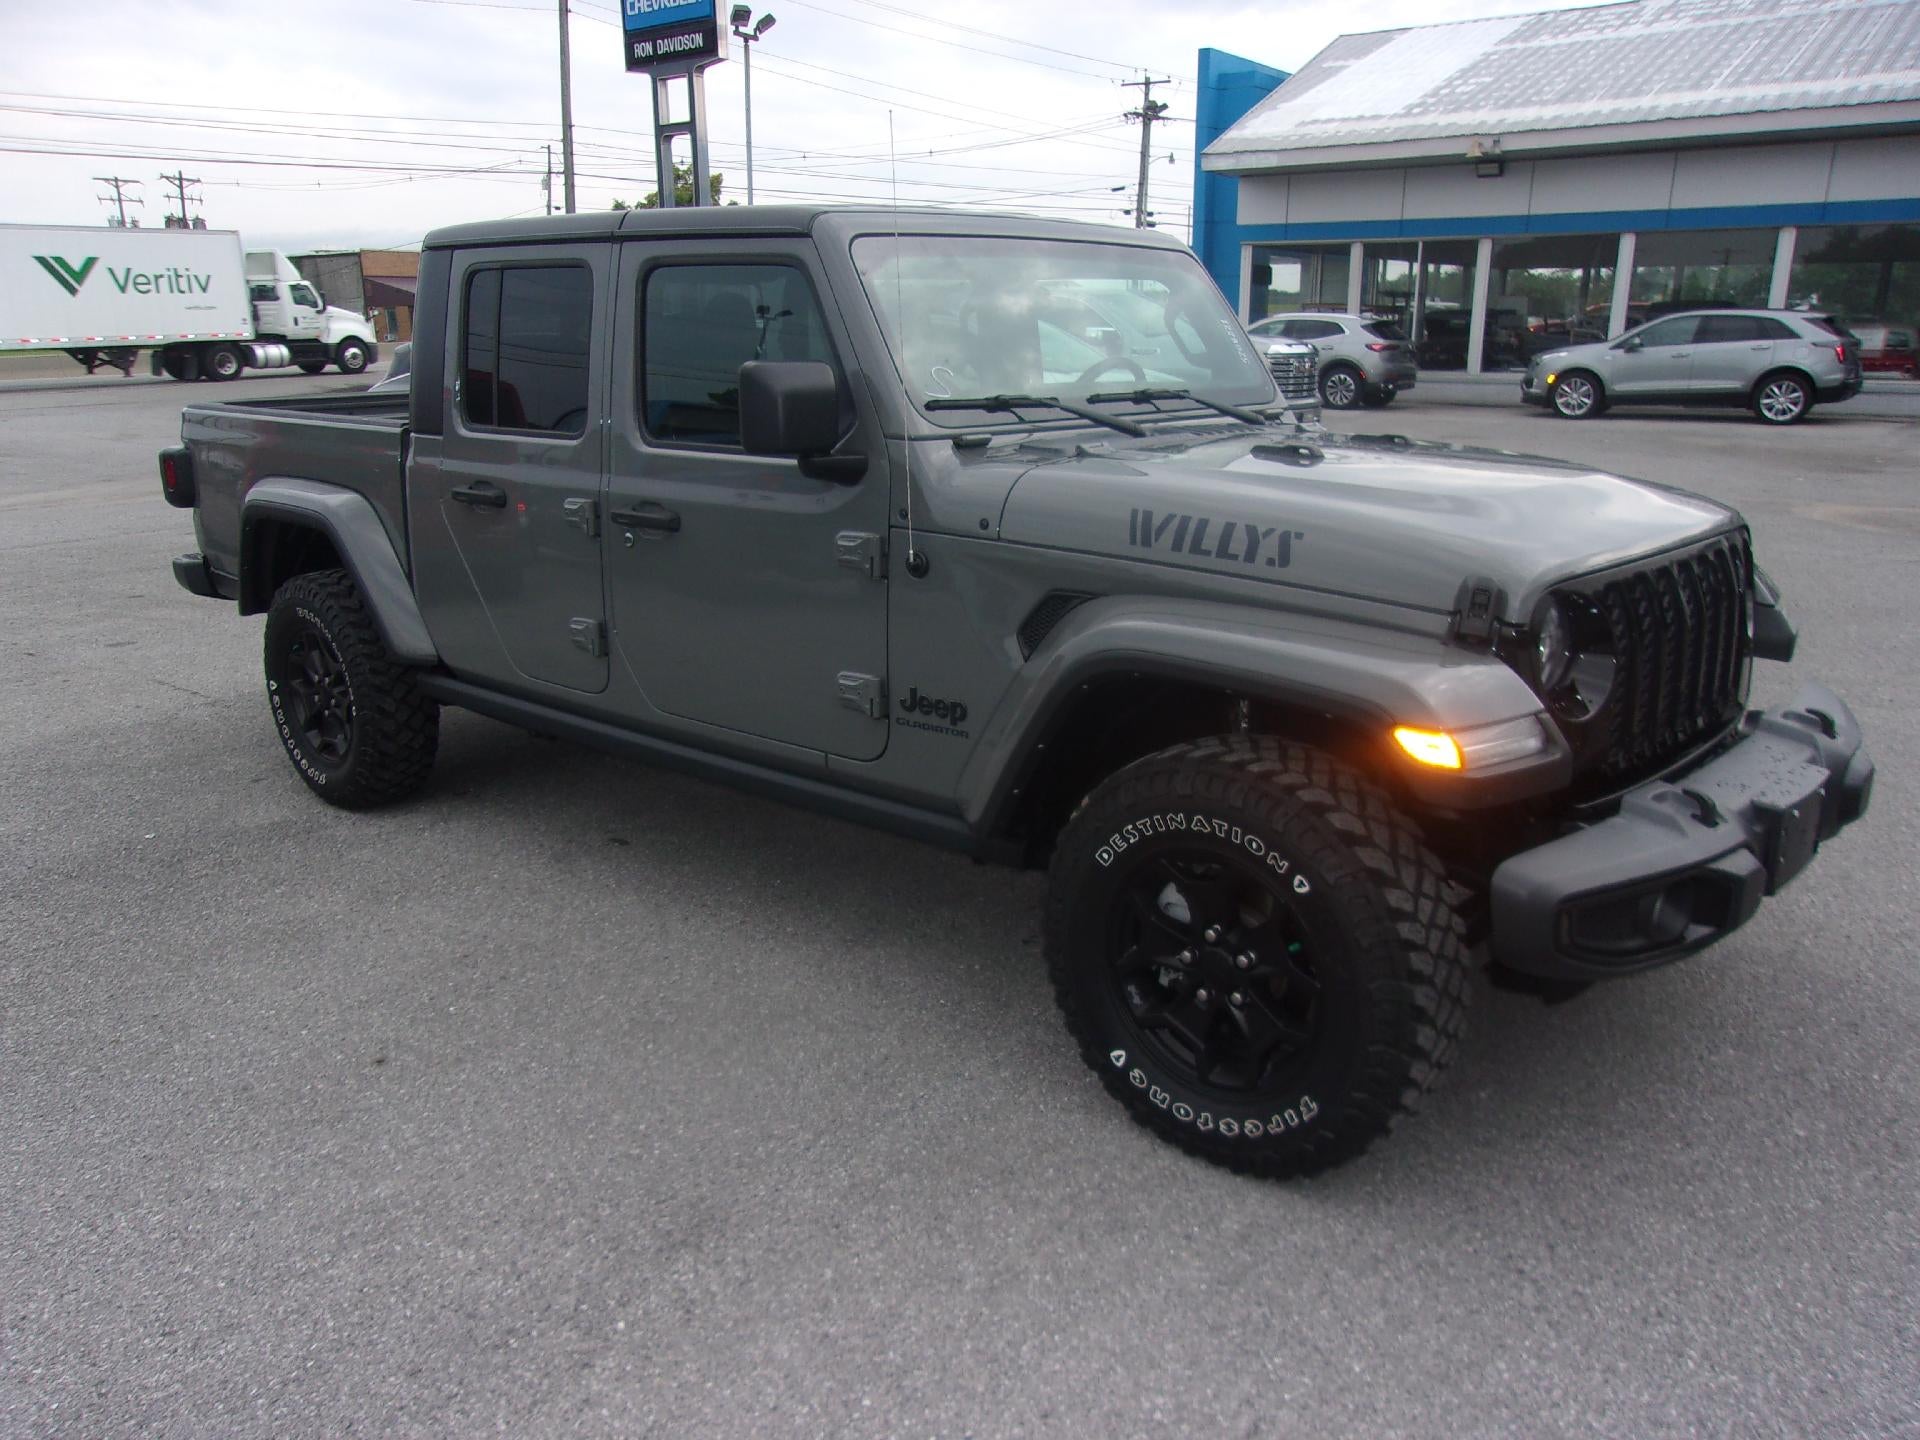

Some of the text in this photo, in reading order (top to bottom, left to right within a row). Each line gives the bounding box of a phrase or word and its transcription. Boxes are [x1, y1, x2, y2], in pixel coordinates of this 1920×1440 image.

[626, 0, 702, 16] CHEVR
[634, 32, 703, 59] RON DAVIDSON
[107, 266, 211, 294] Veritiv
[1129, 508, 1304, 568] WILLYS
[899, 687, 968, 726] Jeep
[896, 717, 968, 739] GLADIATOR
[1095, 812, 1289, 874] DESTINATION
